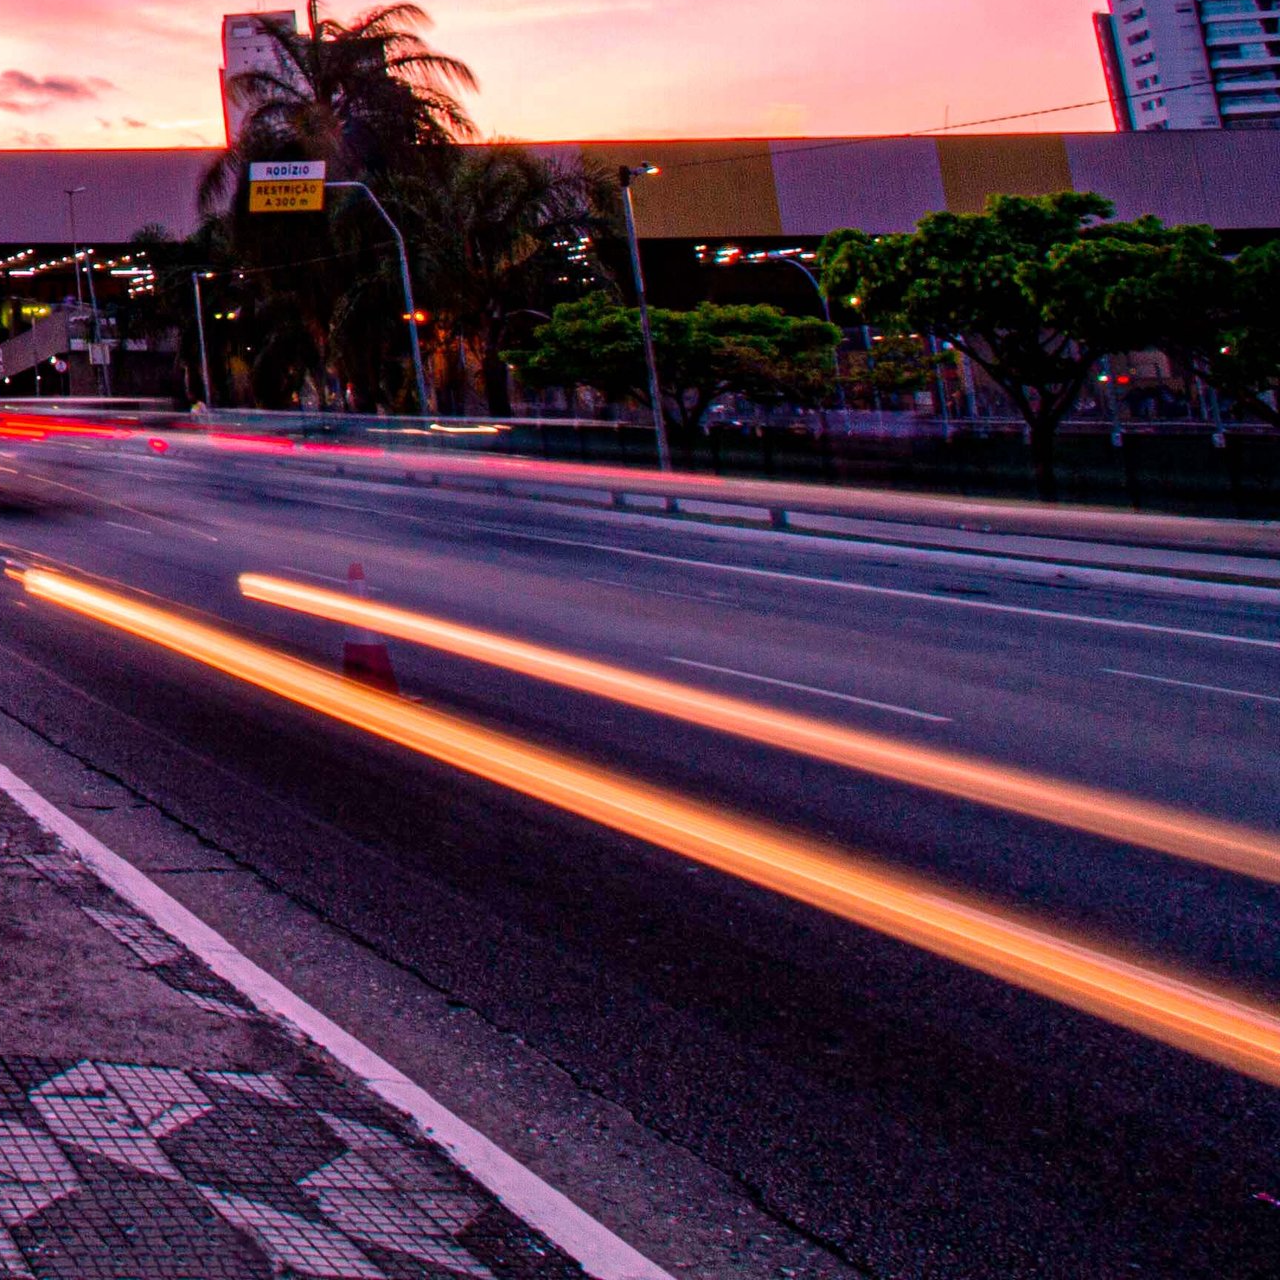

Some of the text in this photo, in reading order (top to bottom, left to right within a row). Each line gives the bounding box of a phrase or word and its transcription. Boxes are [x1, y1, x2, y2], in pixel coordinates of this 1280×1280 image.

[265, 164, 310, 176] RODÍZIO
[256, 183, 317, 196] RESTRIÇÃO
[265, 198, 272, 206] A
[275, 198, 297, 207] 300
